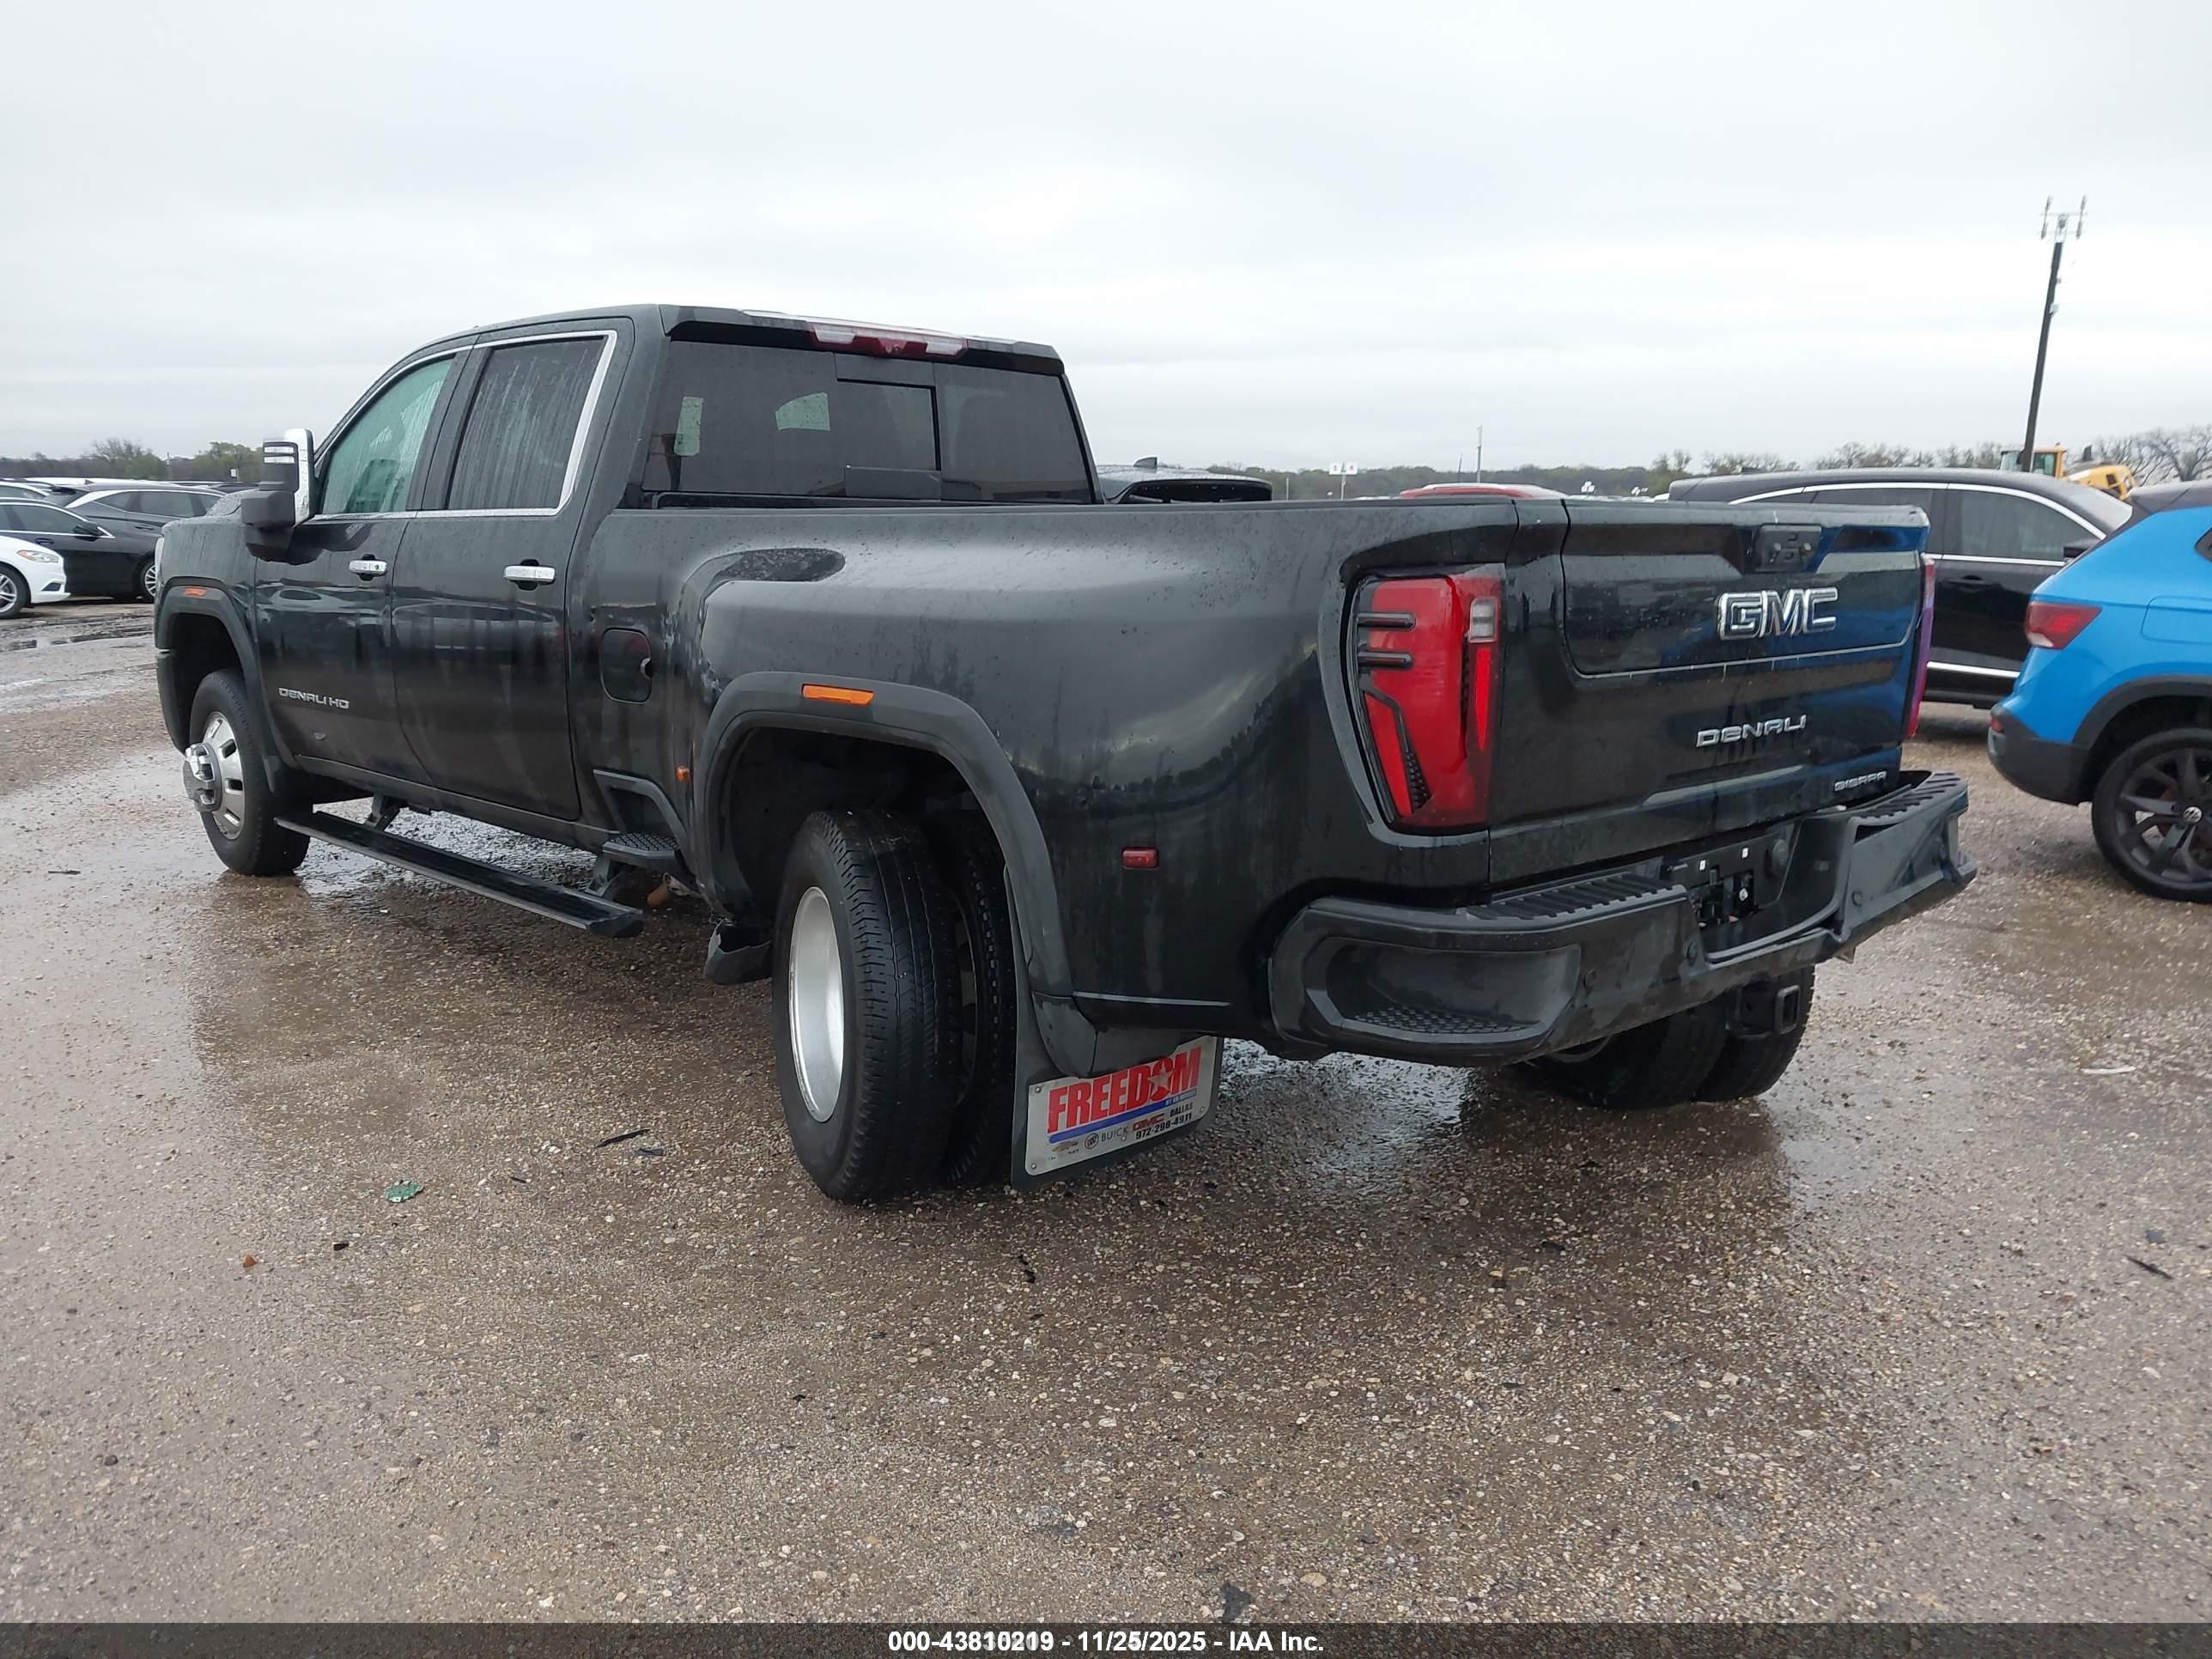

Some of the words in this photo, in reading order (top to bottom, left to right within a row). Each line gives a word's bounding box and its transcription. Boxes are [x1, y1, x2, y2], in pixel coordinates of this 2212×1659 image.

[1718, 586, 1838, 640] GMC
[278, 687, 327, 705] DENALI
[328, 696, 350, 709] HD
[1696, 714, 1807, 747] DENALI
[1048, 1046, 1201, 1133] FREEDOM
[1170, 1102, 1194, 1117] DALLAS
[1101, 1125, 1129, 1142] BUICK
